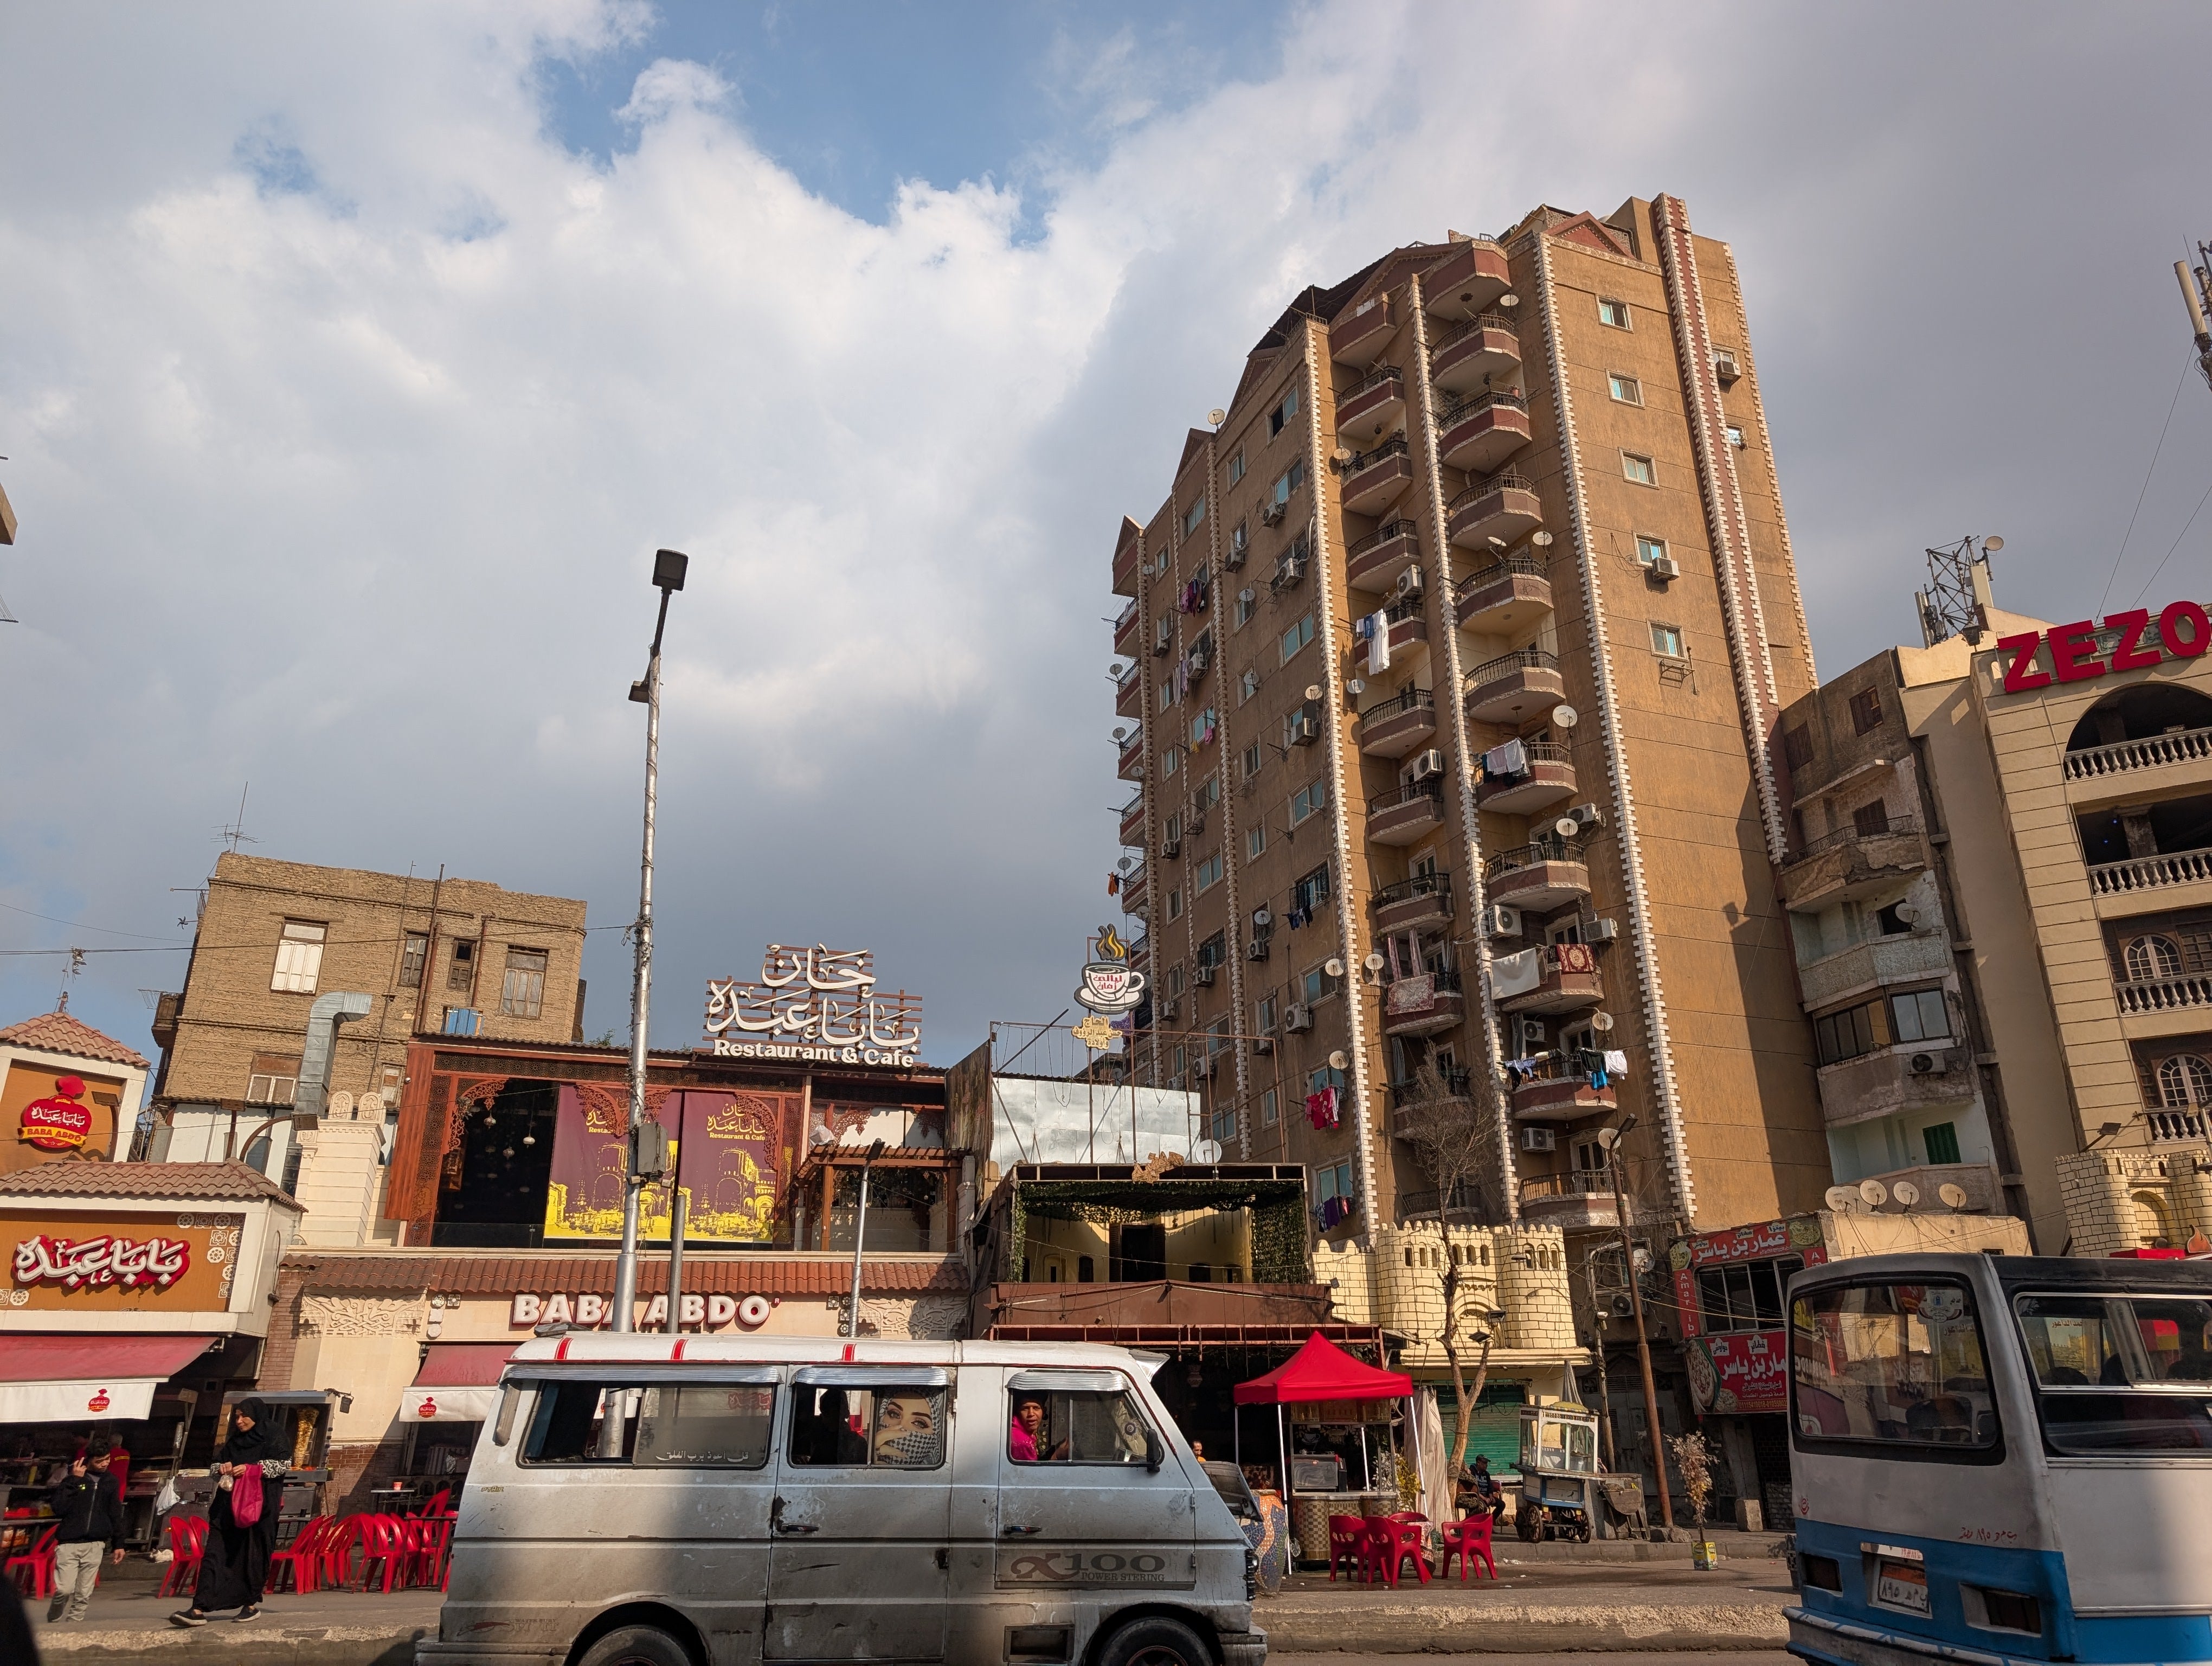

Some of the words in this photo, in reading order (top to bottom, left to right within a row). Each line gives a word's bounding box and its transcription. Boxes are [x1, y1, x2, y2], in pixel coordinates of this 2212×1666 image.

[1997, 600, 2211, 693] ZEZO
[761, 941, 877, 998] خان
[706, 979, 820, 1040] عبده
[821, 997, 919, 1054] بابا
[1084, 1016, 1108, 1027] الحاج
[1096, 1029, 1107, 1037] عبد
[713, 1039, 838, 1062] Restaurant
[841, 1046, 860, 1064] &
[864, 1048, 915, 1068] Cafe
[31, 1106, 62, 1124] عبده
[62, 1111, 85, 1127] بابا
[706, 1114, 739, 1132] عبده
[55, 1130, 81, 1142] ABDO
[709, 1132, 744, 1140] Restaurant
[1694, 1241, 1730, 1263] ياسر
[1731, 1239, 1748, 1257] بن
[1752, 1234, 1785, 1252] عمار
[16, 1236, 113, 1286] عبده
[110, 1239, 183, 1285] بابا
[1681, 1273, 1689, 1305] Amar
[643, 1295, 770, 1326] ABDO
[1721, 1355, 1751, 1381] ياسر
[1752, 1354, 1766, 1380] بن
[655, 1450, 686, 1461] الفلق
[707, 1450, 726, 1462] أعوذ
[727, 1451, 749, 1463] قل
[1121, 1573, 1165, 1582] STERING
